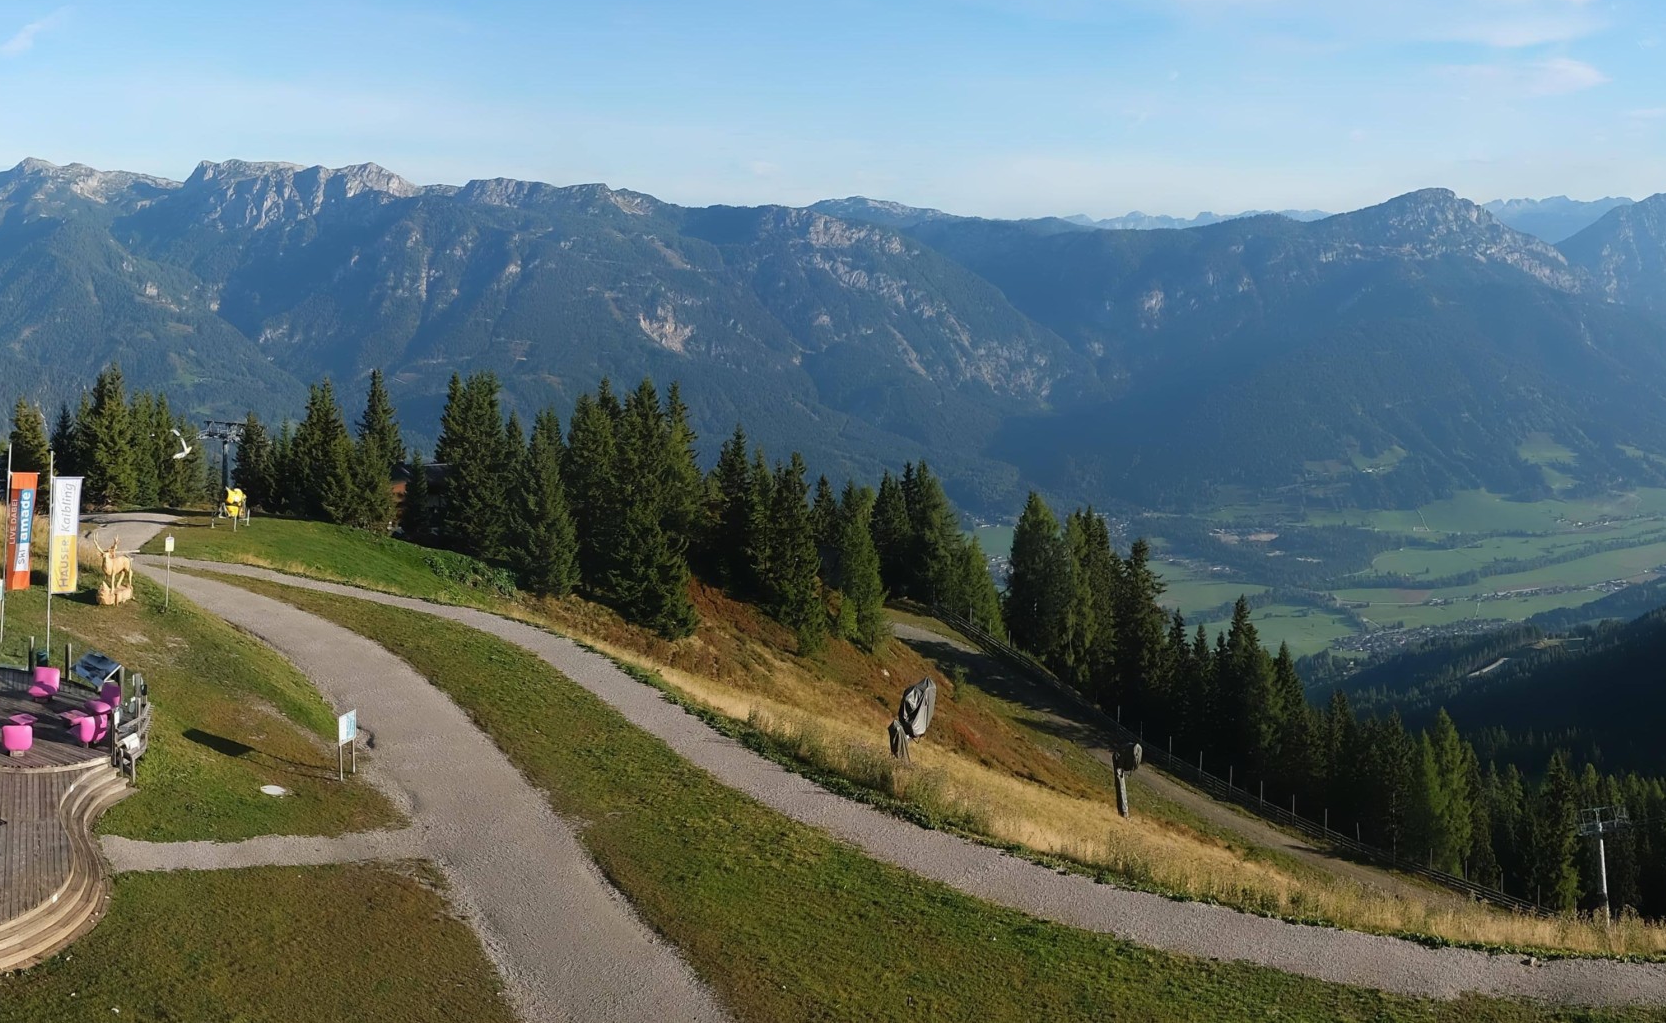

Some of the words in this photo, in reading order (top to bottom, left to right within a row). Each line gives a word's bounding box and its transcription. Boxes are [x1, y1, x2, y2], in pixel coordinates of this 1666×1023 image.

[10, 499, 18, 525] DABEI
[60, 483, 76, 533] Kaibling
[9, 526, 17, 545] LIVE
[18, 549, 26, 565] Ski
[58, 540, 69, 588] HAUSER
